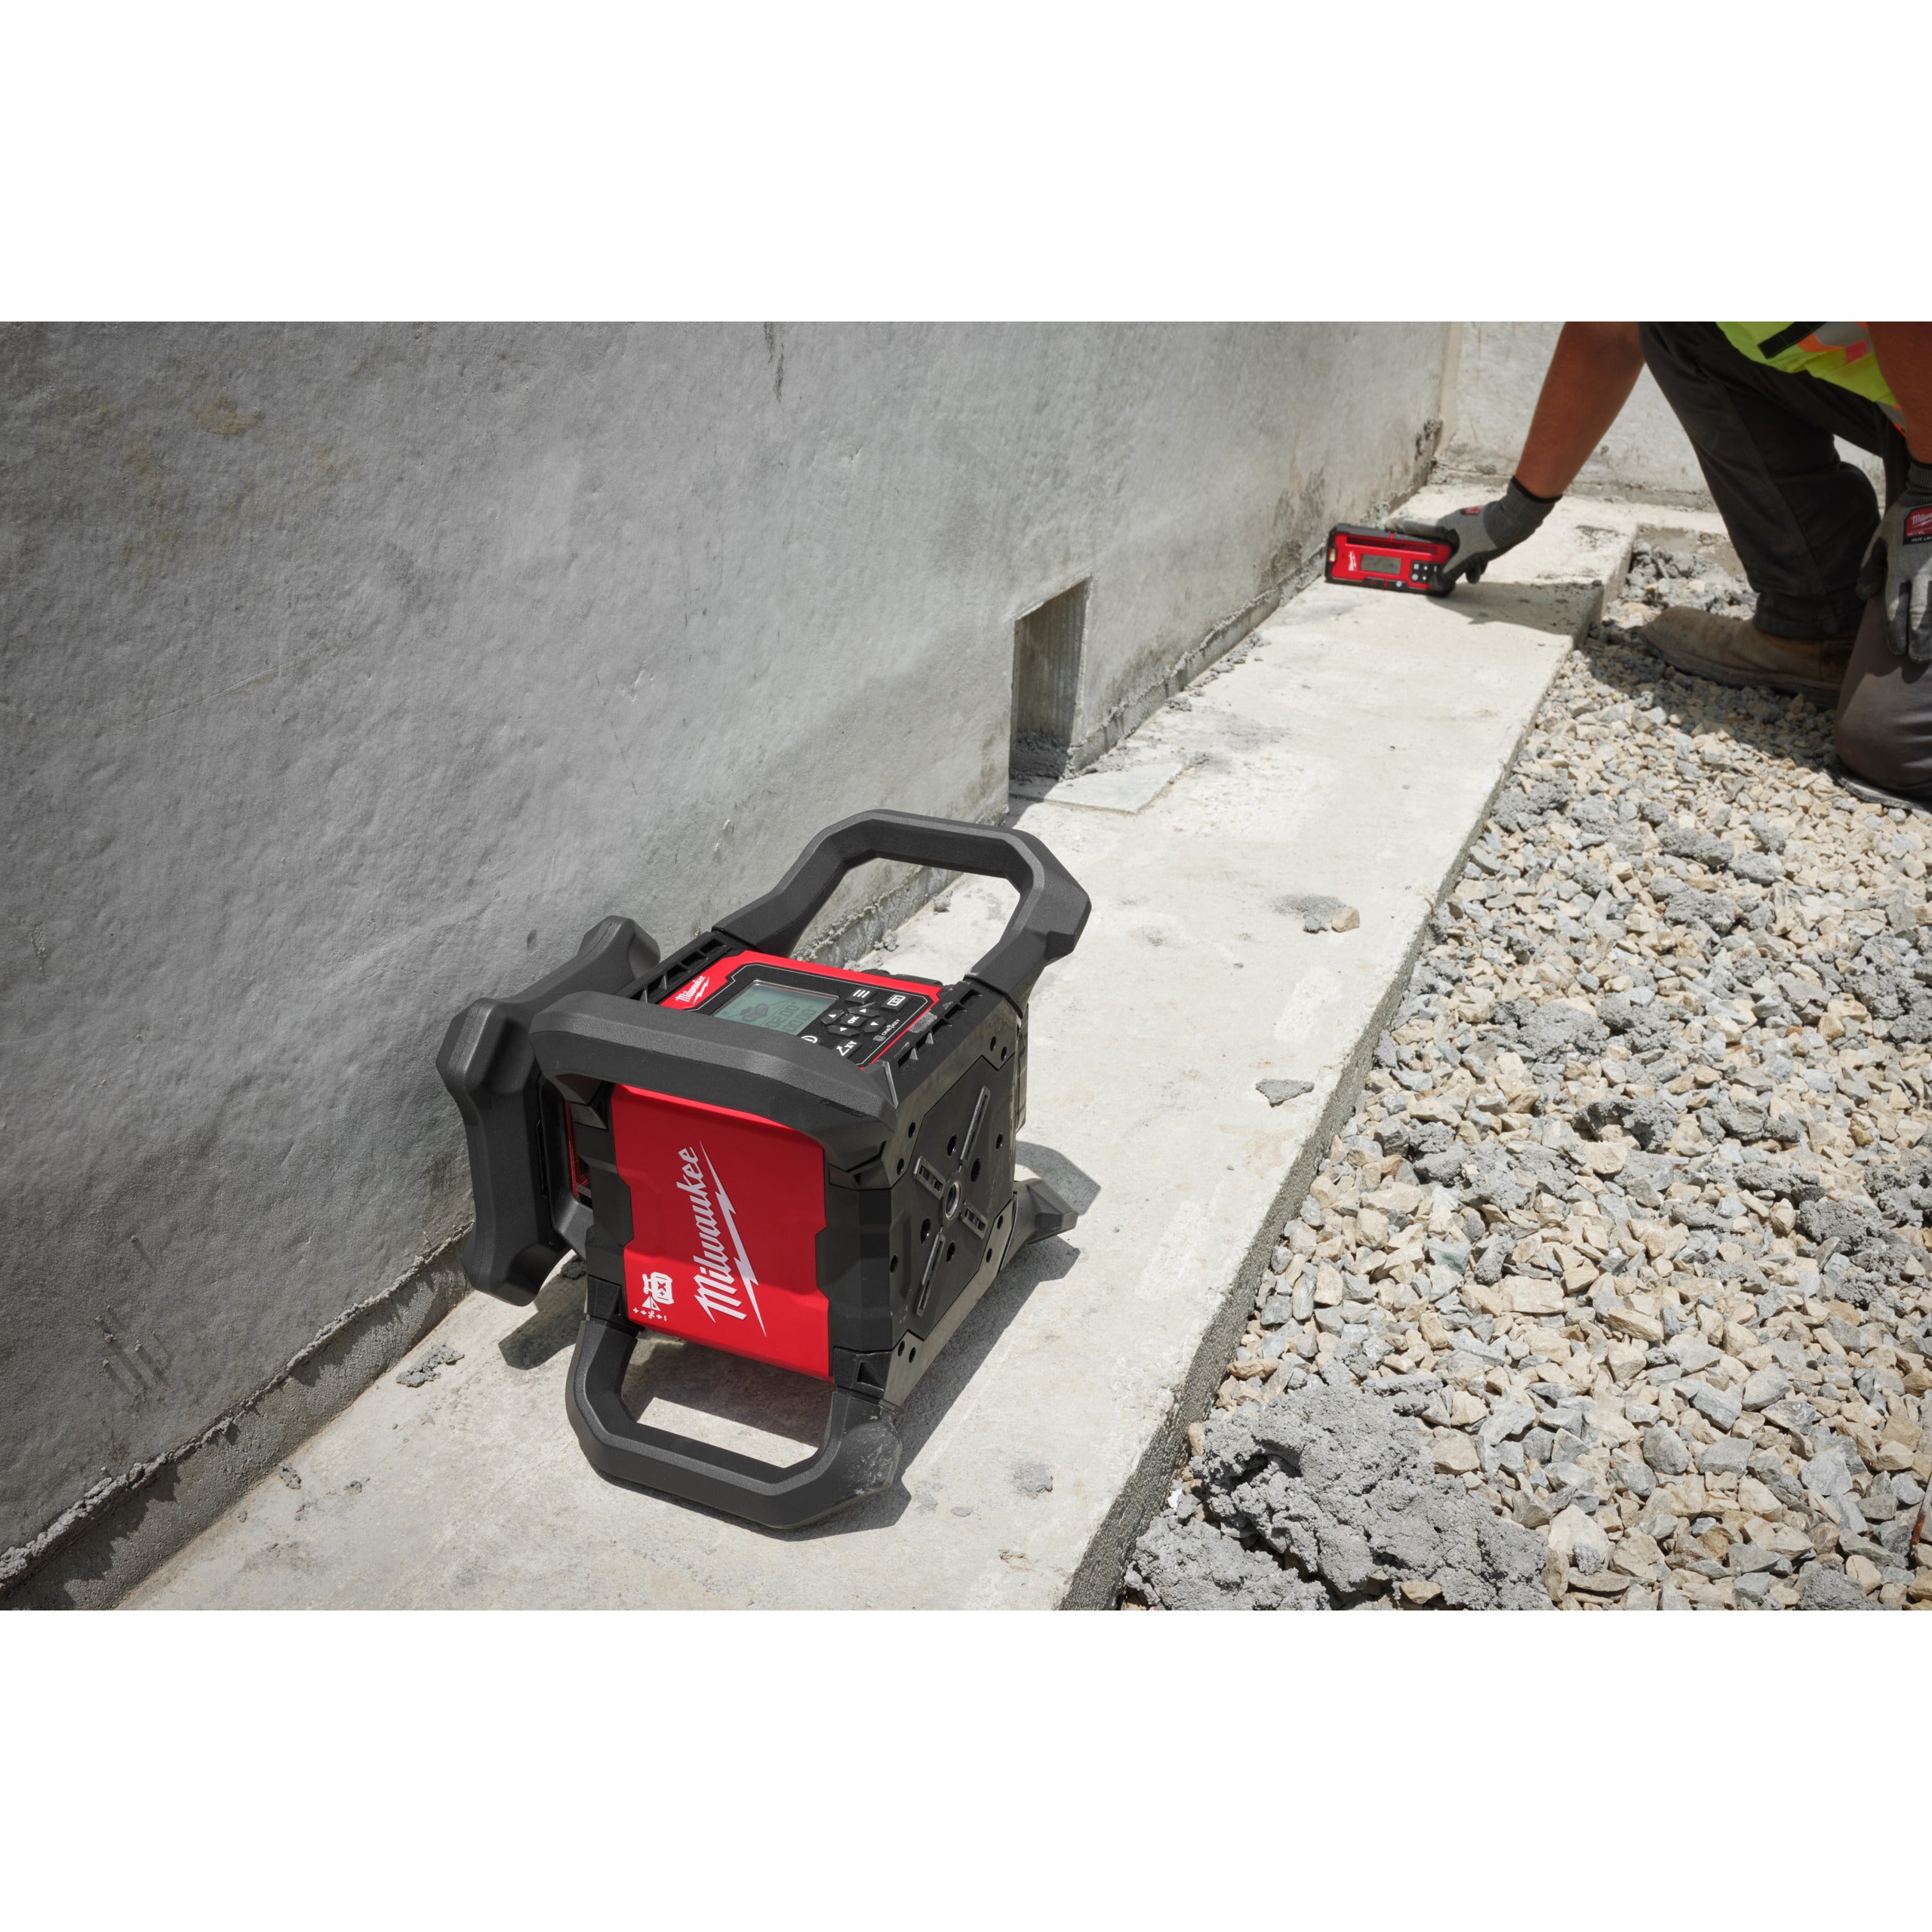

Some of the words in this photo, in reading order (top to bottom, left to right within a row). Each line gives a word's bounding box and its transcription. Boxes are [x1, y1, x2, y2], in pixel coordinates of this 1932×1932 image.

[675, 976, 706, 1002] Milwaukee
[848, 1016, 860, 1024] OK
[844, 1040, 857, 1048] XY
[676, 1146, 747, 1323] Milwaukee
